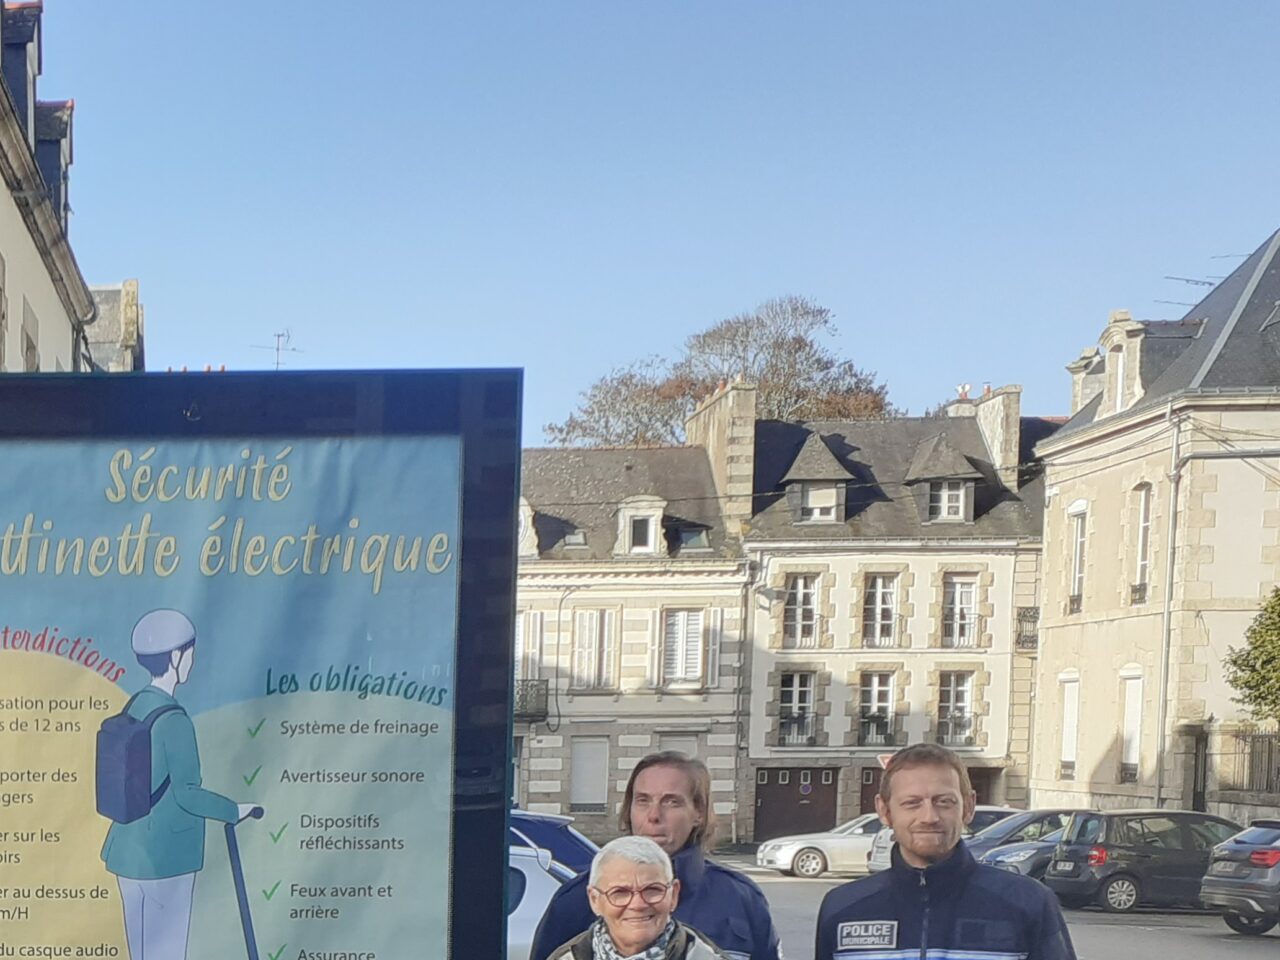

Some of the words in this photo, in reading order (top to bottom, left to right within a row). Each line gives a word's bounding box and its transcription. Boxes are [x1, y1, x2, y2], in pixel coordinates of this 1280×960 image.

[105, 446, 293, 503] Sécurité
[199, 515, 452, 595] électrique
[265, 667, 300, 697] Les
[309, 664, 448, 707] obligations
[48, 699, 85, 714] pour
[89, 695, 110, 711] les
[9, 718, 29, 732] de
[34, 718, 51, 732] 12
[55, 721, 82, 733] ans
[280, 719, 346, 739] Système
[349, 719, 370, 734] de
[373, 719, 439, 737] freinage
[51, 768, 78, 783] des
[280, 768, 367, 784] Avertisseur
[371, 771, 425, 784] sonore
[300, 813, 380, 832] Dispositifs
[13, 831, 36, 843] sur
[40, 828, 61, 843] les
[299, 835, 405, 851] réfléchissants
[12, 887, 32, 899] au
[35, 885, 86, 899] dessus
[89, 885, 110, 899] de
[290, 883, 327, 898] Feux
[330, 885, 373, 898] avant
[377, 884, 393, 898] et
[289, 904, 340, 919] arrière
[841, 924, 891, 937] POLICE
[18, 945, 72, 960] casque
[75, 943, 120, 958] audio
